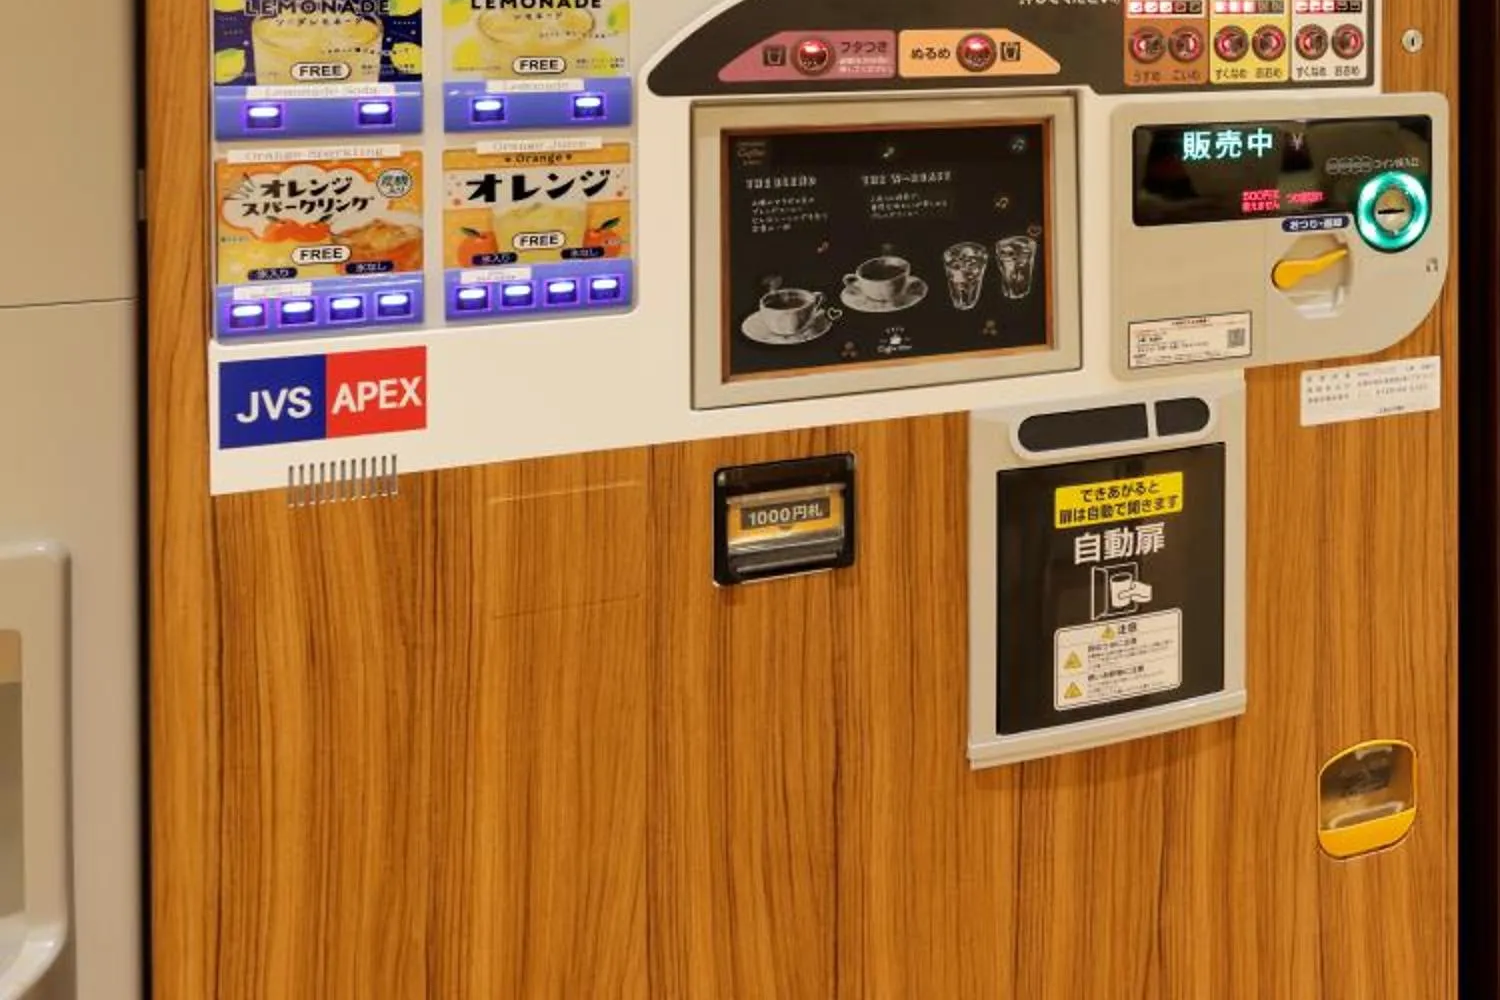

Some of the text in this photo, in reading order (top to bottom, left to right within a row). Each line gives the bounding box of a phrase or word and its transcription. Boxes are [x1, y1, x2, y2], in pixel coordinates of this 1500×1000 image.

[841, 40, 888, 54] フタつき
[299, 65, 342, 77] FREE
[519, 59, 559, 71] FREE
[1181, 127, 1274, 161] 販売中
[515, 153, 563, 164] Orange
[259, 176, 353, 199] オレンジ
[466, 168, 611, 203] オレンジ
[241, 196, 375, 217] スパークリング
[519, 234, 559, 247] FREE
[300, 248, 343, 261] FREE
[235, 375, 423, 424] JVS APEX
[1080, 481, 1160, 503] できあがると
[747, 502, 824, 528] 1000円札
[1059, 495, 1179, 525] 扉は自動で開きます
[1074, 521, 1166, 565] 自動扉
